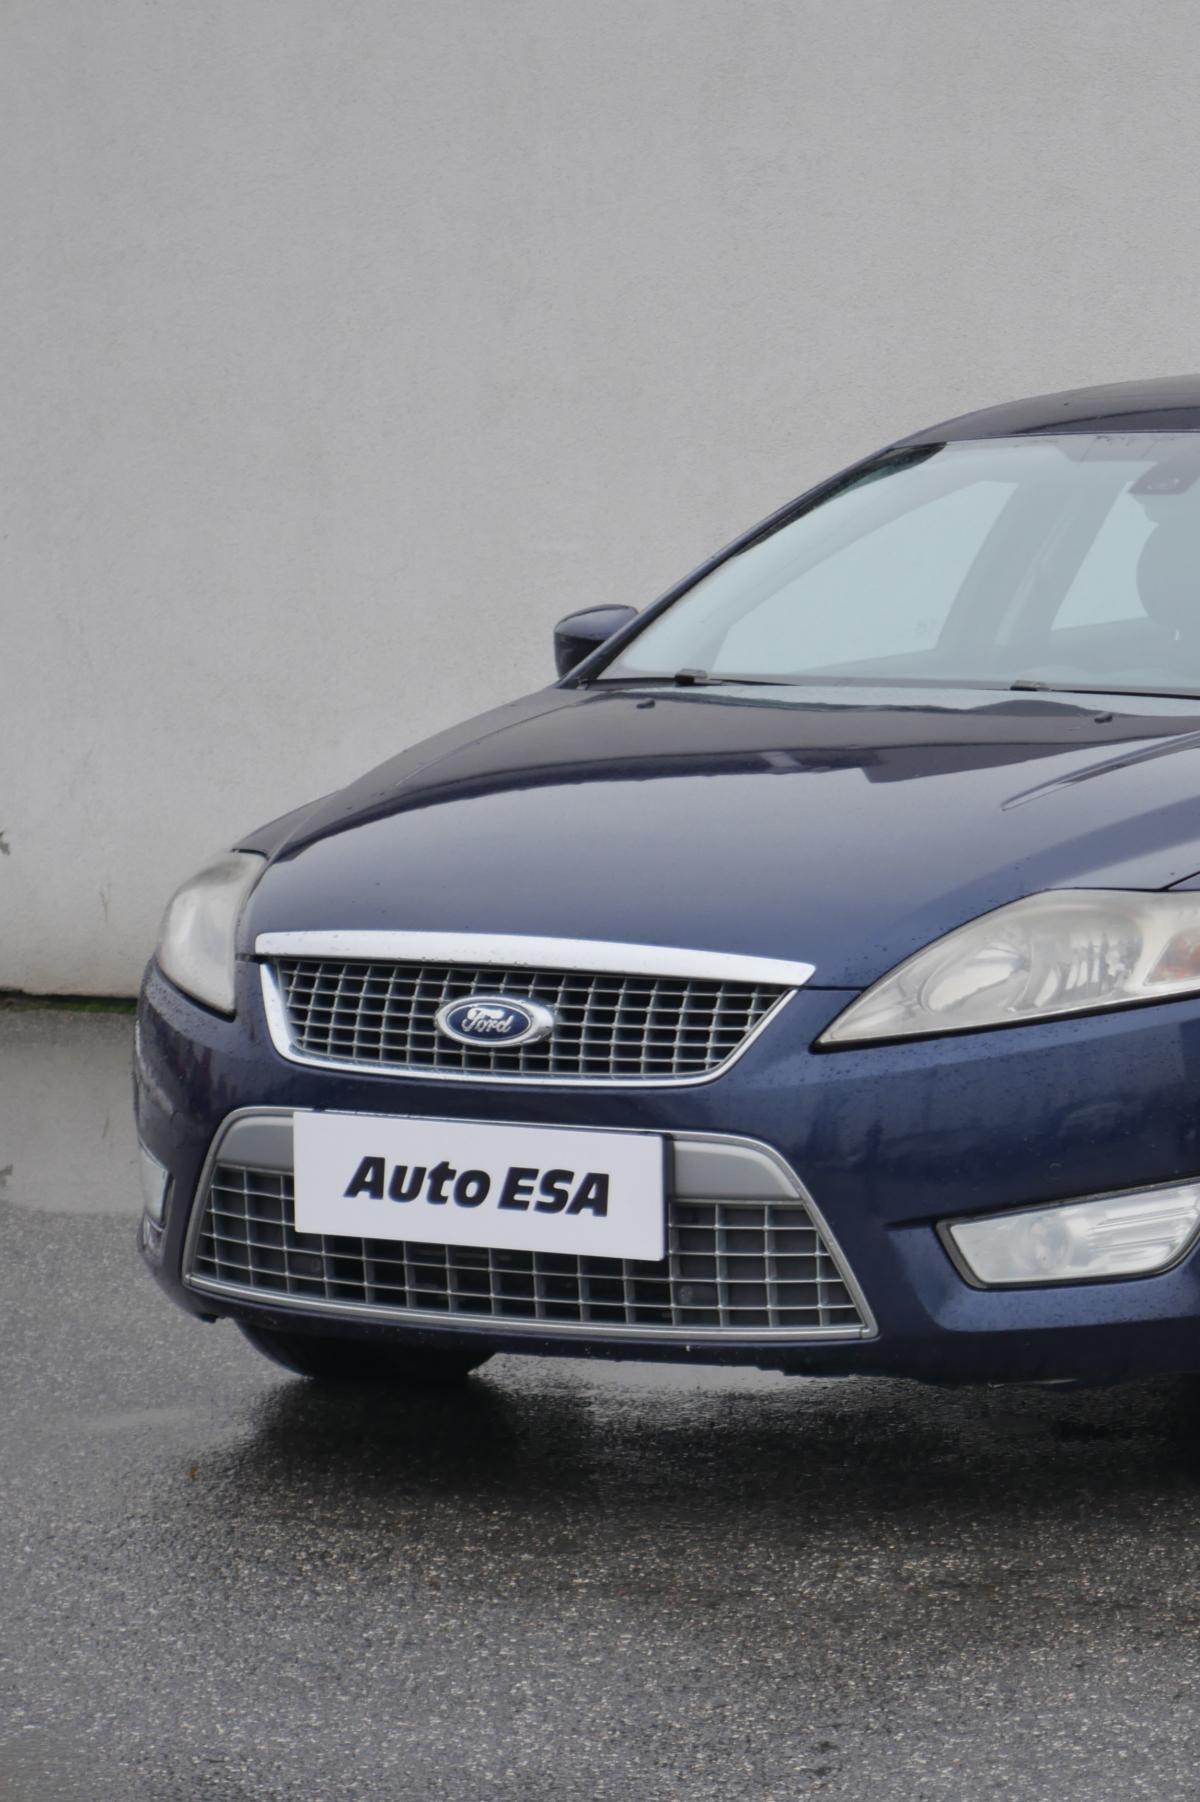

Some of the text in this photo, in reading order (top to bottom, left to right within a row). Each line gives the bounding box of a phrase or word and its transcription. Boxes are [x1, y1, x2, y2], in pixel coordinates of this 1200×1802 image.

[461, 1007, 515, 1033] Ford
[343, 1155, 610, 1218] Auto ESA
